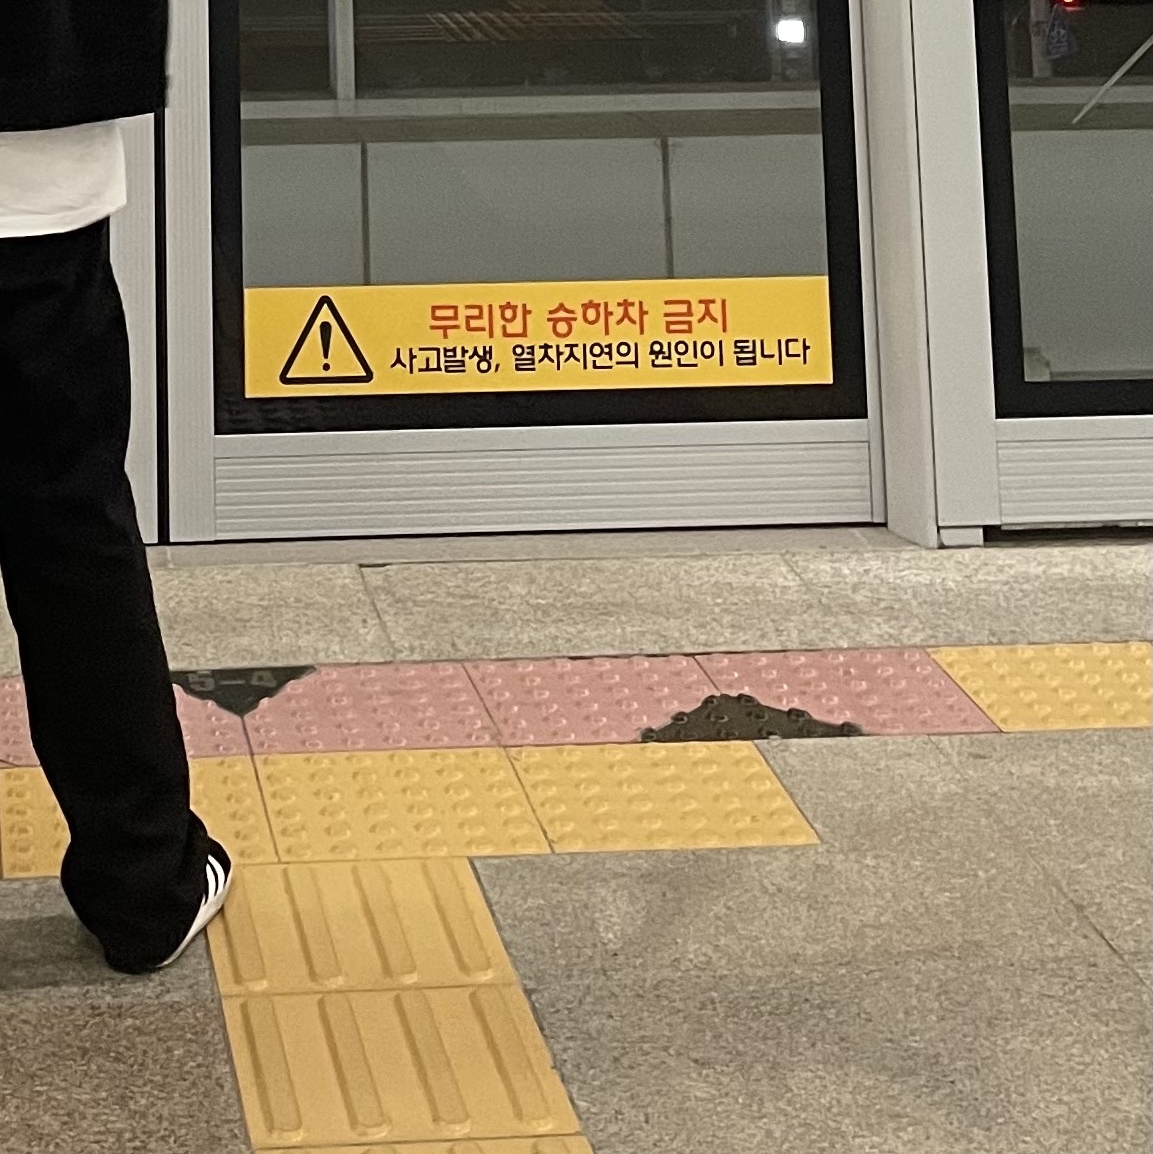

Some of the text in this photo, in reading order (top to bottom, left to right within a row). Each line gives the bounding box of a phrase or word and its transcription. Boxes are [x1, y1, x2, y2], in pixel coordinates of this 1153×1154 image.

[428, 298, 727, 339] 무리한 승하차 금지
[390, 337, 811, 374] 사고발생, 열차지연의 원인이 됩니다
